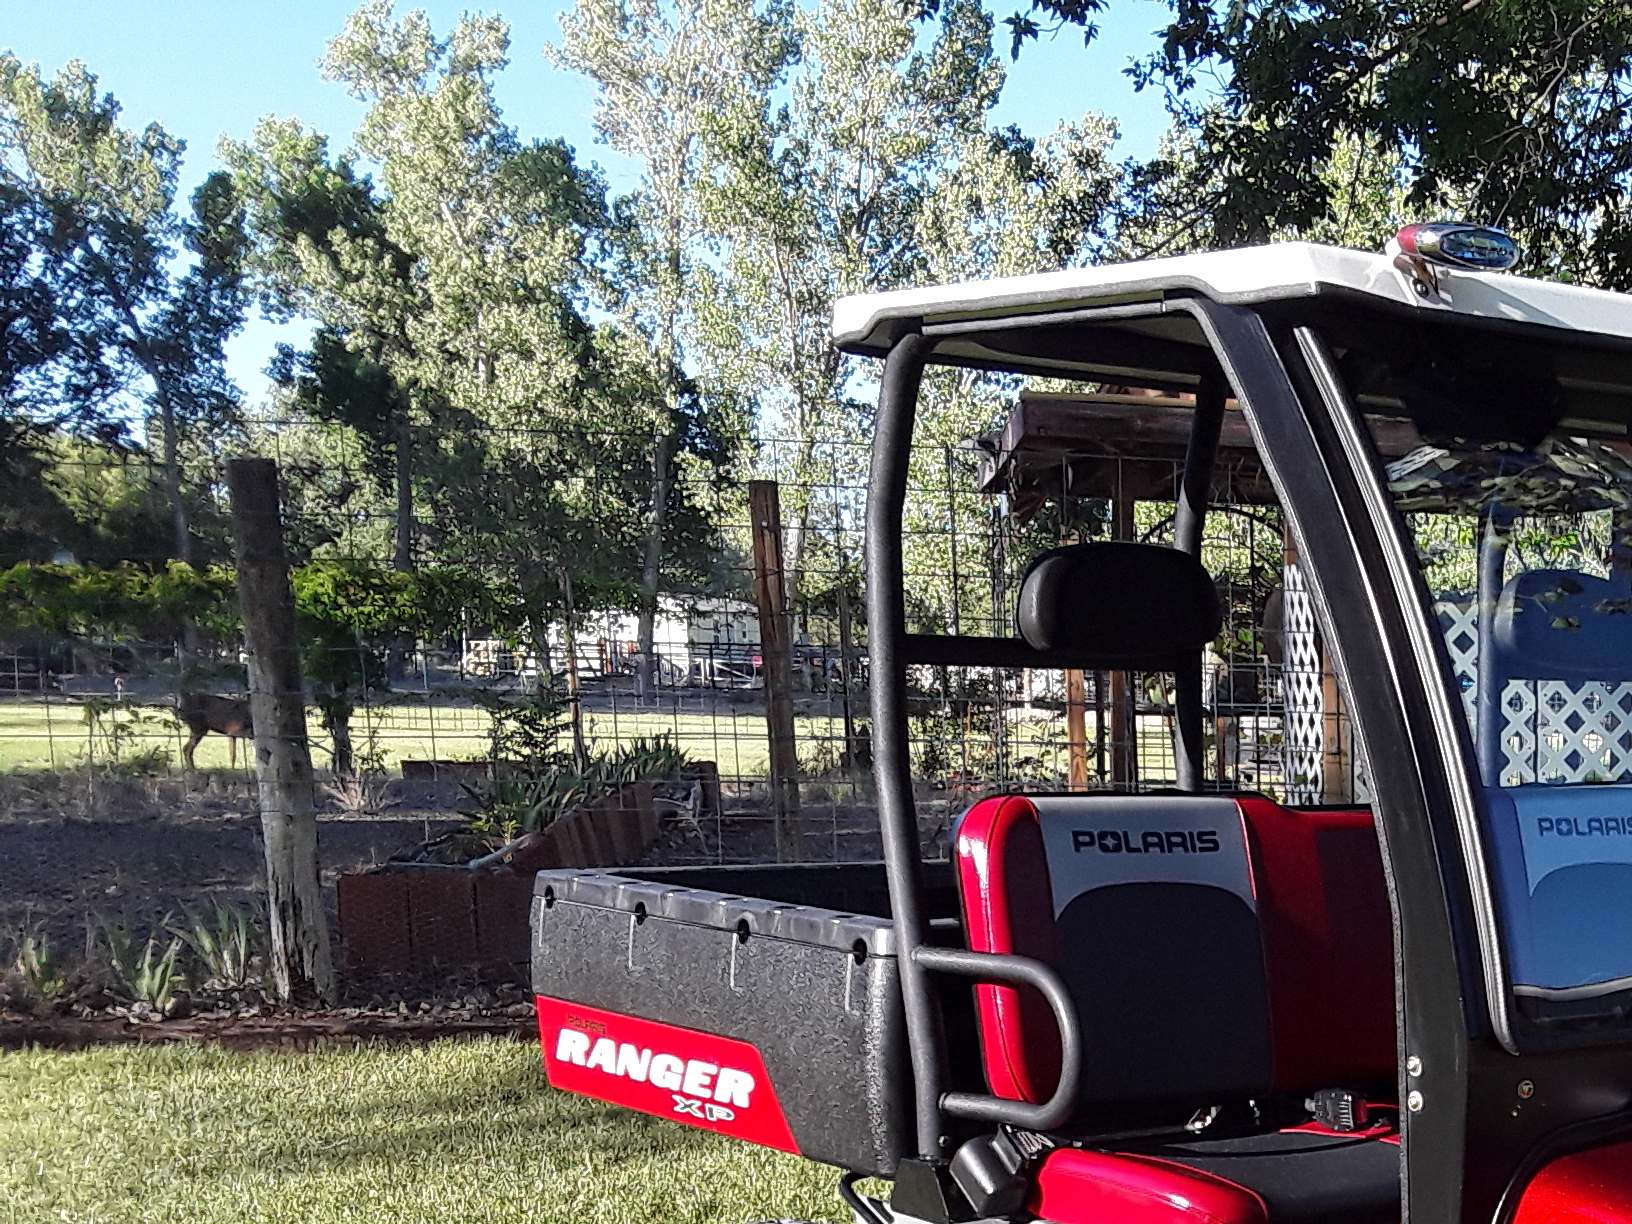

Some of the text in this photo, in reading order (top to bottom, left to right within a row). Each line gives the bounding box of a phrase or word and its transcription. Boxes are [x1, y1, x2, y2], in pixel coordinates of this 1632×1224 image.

[1071, 830, 1220, 854] POLARIS
[555, 1027, 756, 1109] RANGER
[671, 1093, 736, 1121] XP
